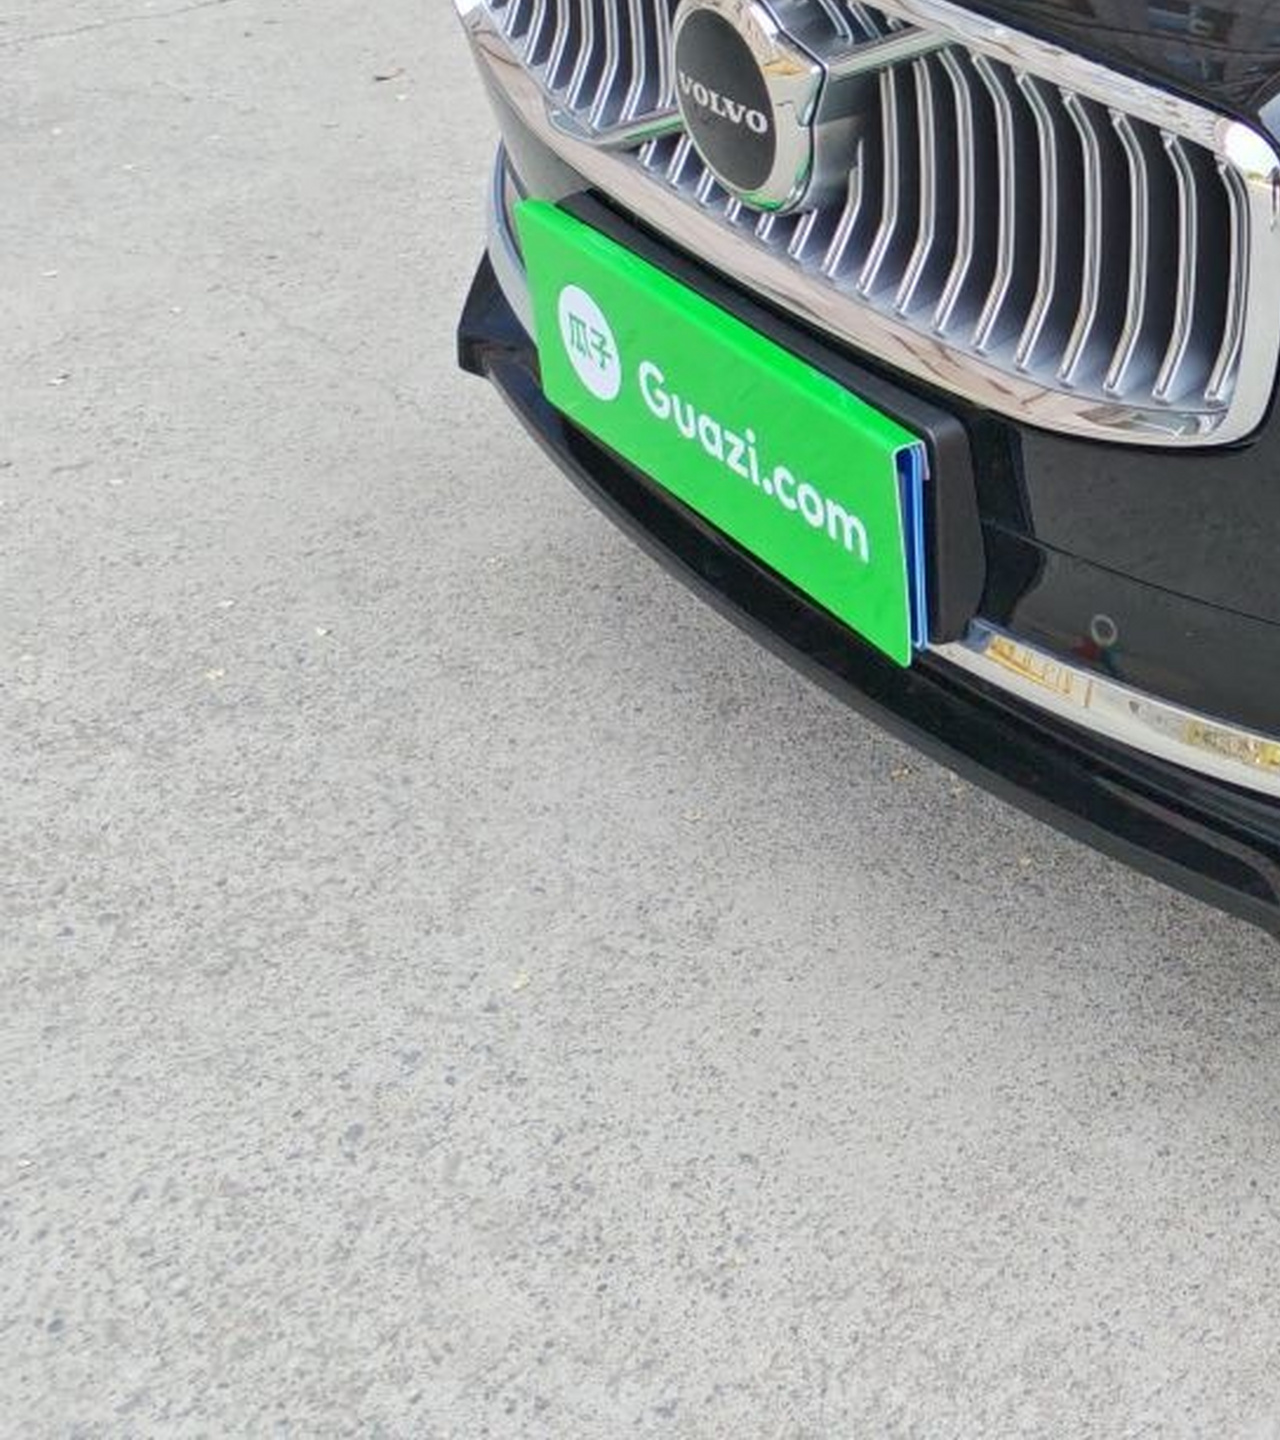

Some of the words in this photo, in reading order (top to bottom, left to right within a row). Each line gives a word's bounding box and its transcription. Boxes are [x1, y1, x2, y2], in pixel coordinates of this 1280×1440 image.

[678, 68, 768, 133] VOLVO
[568, 312, 613, 370] 瓜子
[639, 360, 870, 564] Guazi.com
